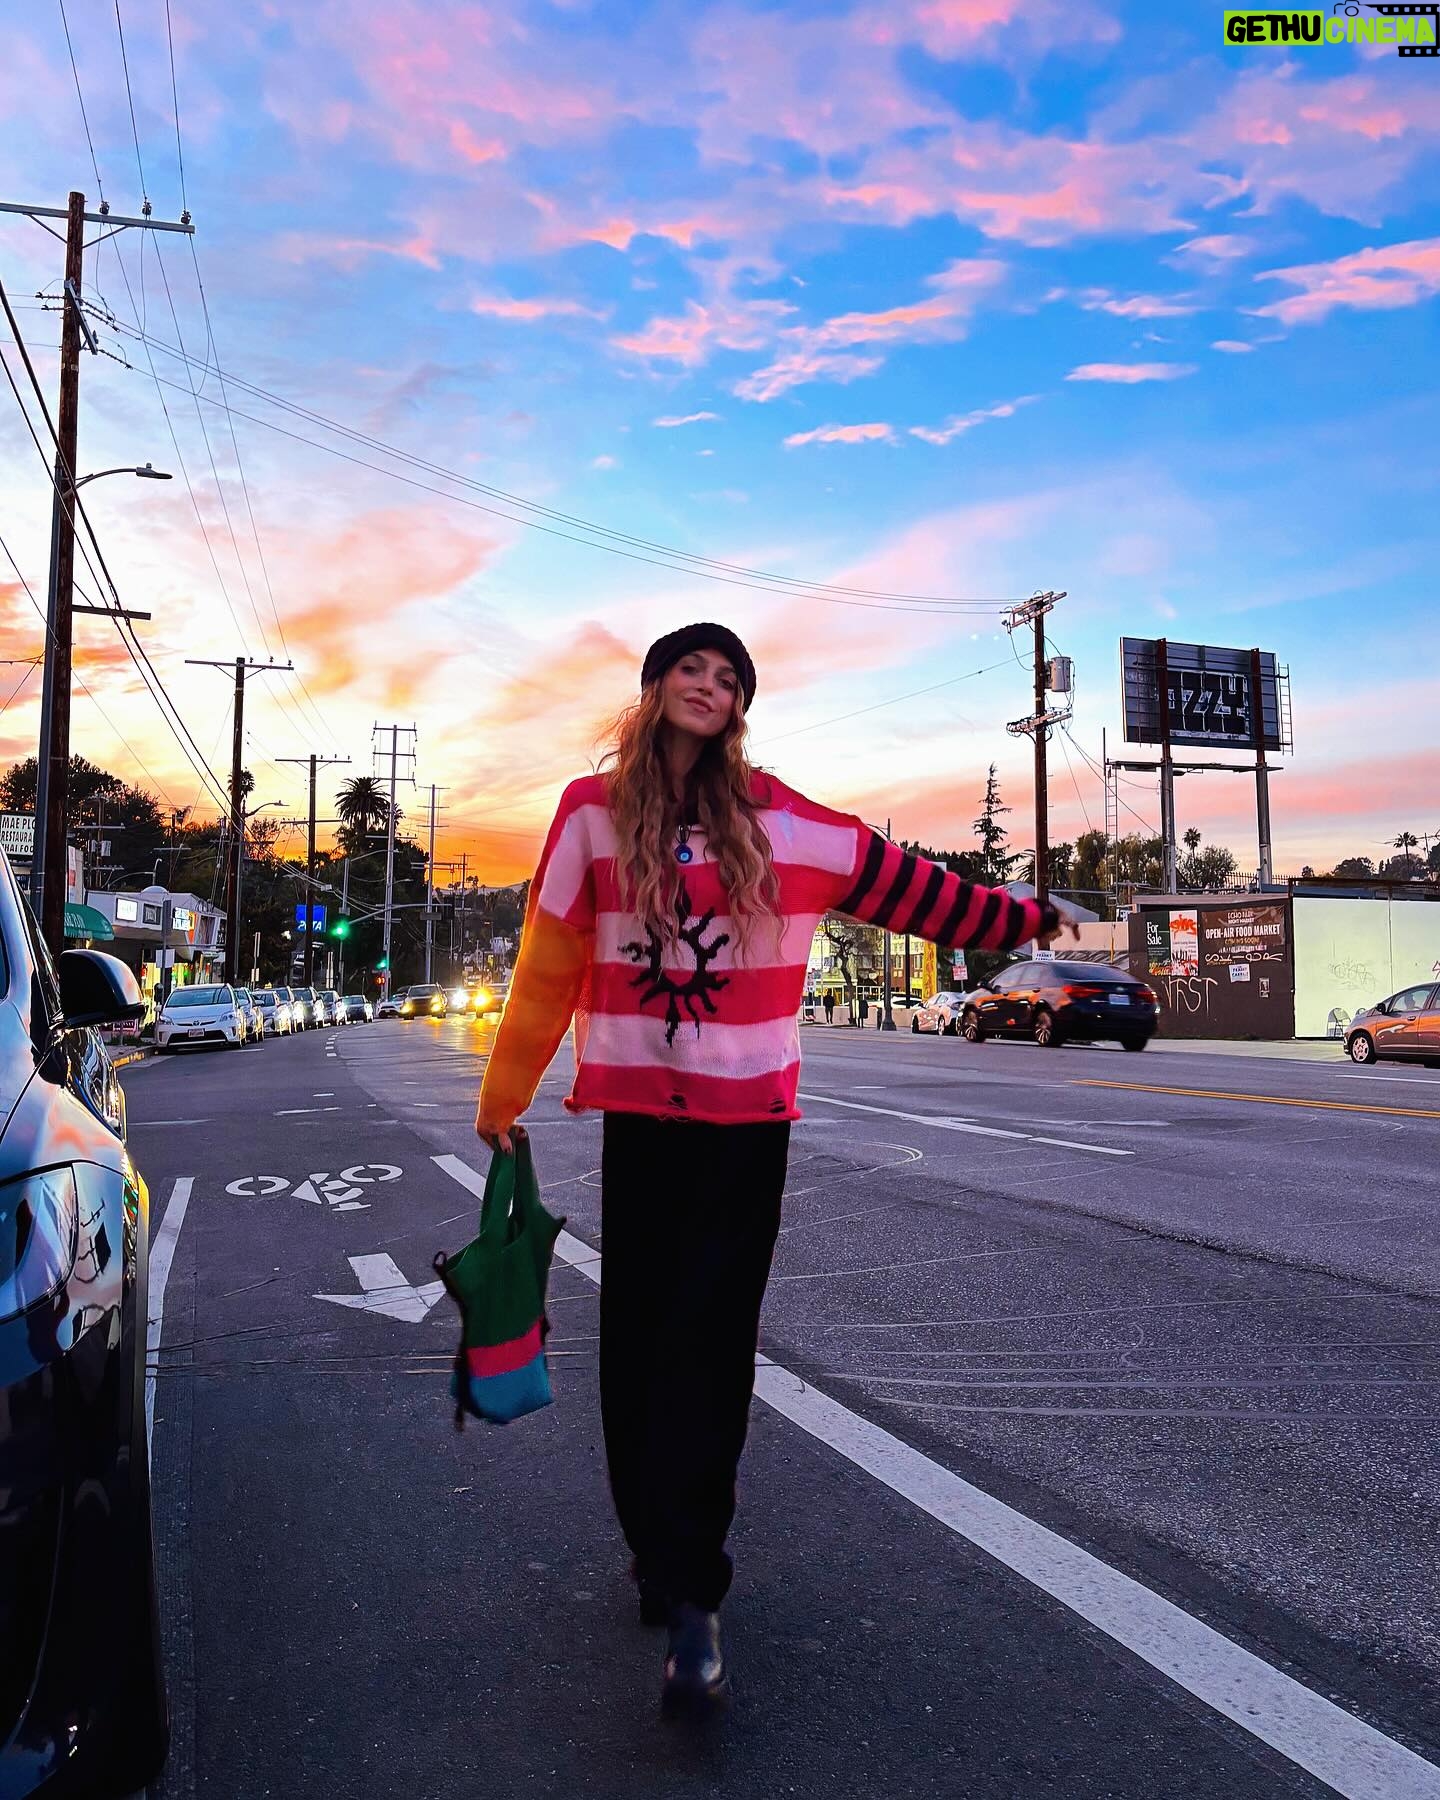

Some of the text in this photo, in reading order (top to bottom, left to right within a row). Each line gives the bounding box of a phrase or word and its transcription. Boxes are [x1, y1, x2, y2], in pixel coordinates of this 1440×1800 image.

[2, 817, 36, 830] MAE PLO
[1, 831, 33, 842] RESTAURA
[20, 845, 34, 853] FOO
[1146, 921, 1159, 934] For
[1205, 923, 1280, 939] OPEN-AIR FOOD MARKET
[1147, 932, 1162, 945] Sale
